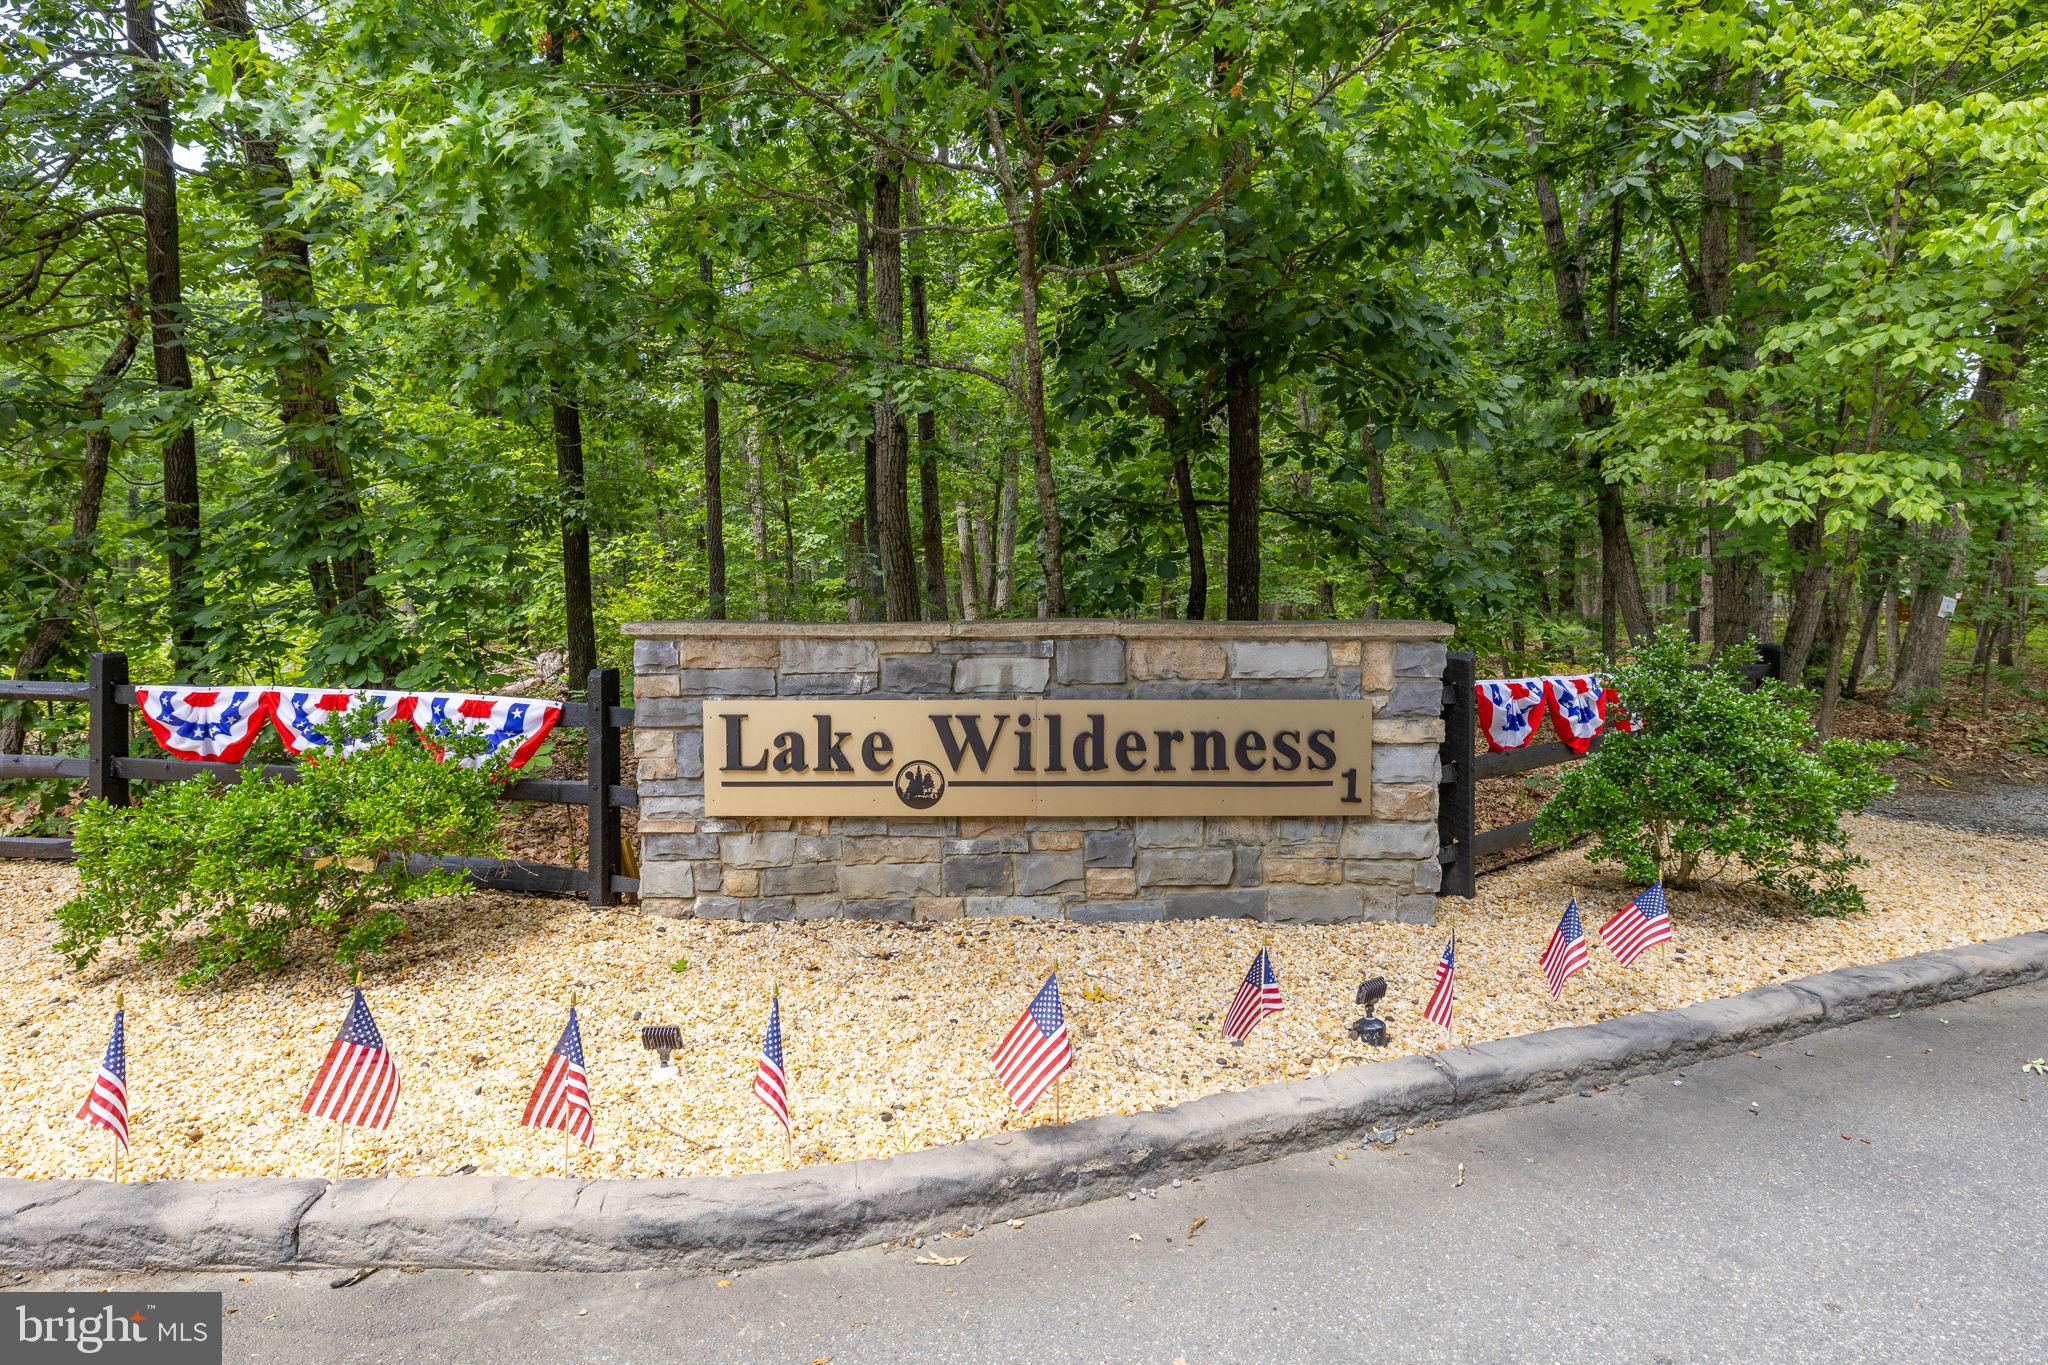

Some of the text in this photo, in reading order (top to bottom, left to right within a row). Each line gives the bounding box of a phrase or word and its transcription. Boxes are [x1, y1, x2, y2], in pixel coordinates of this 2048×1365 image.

[718, 714, 1337, 772] Lake Wilderness
[1340, 768, 1362, 802] 1
